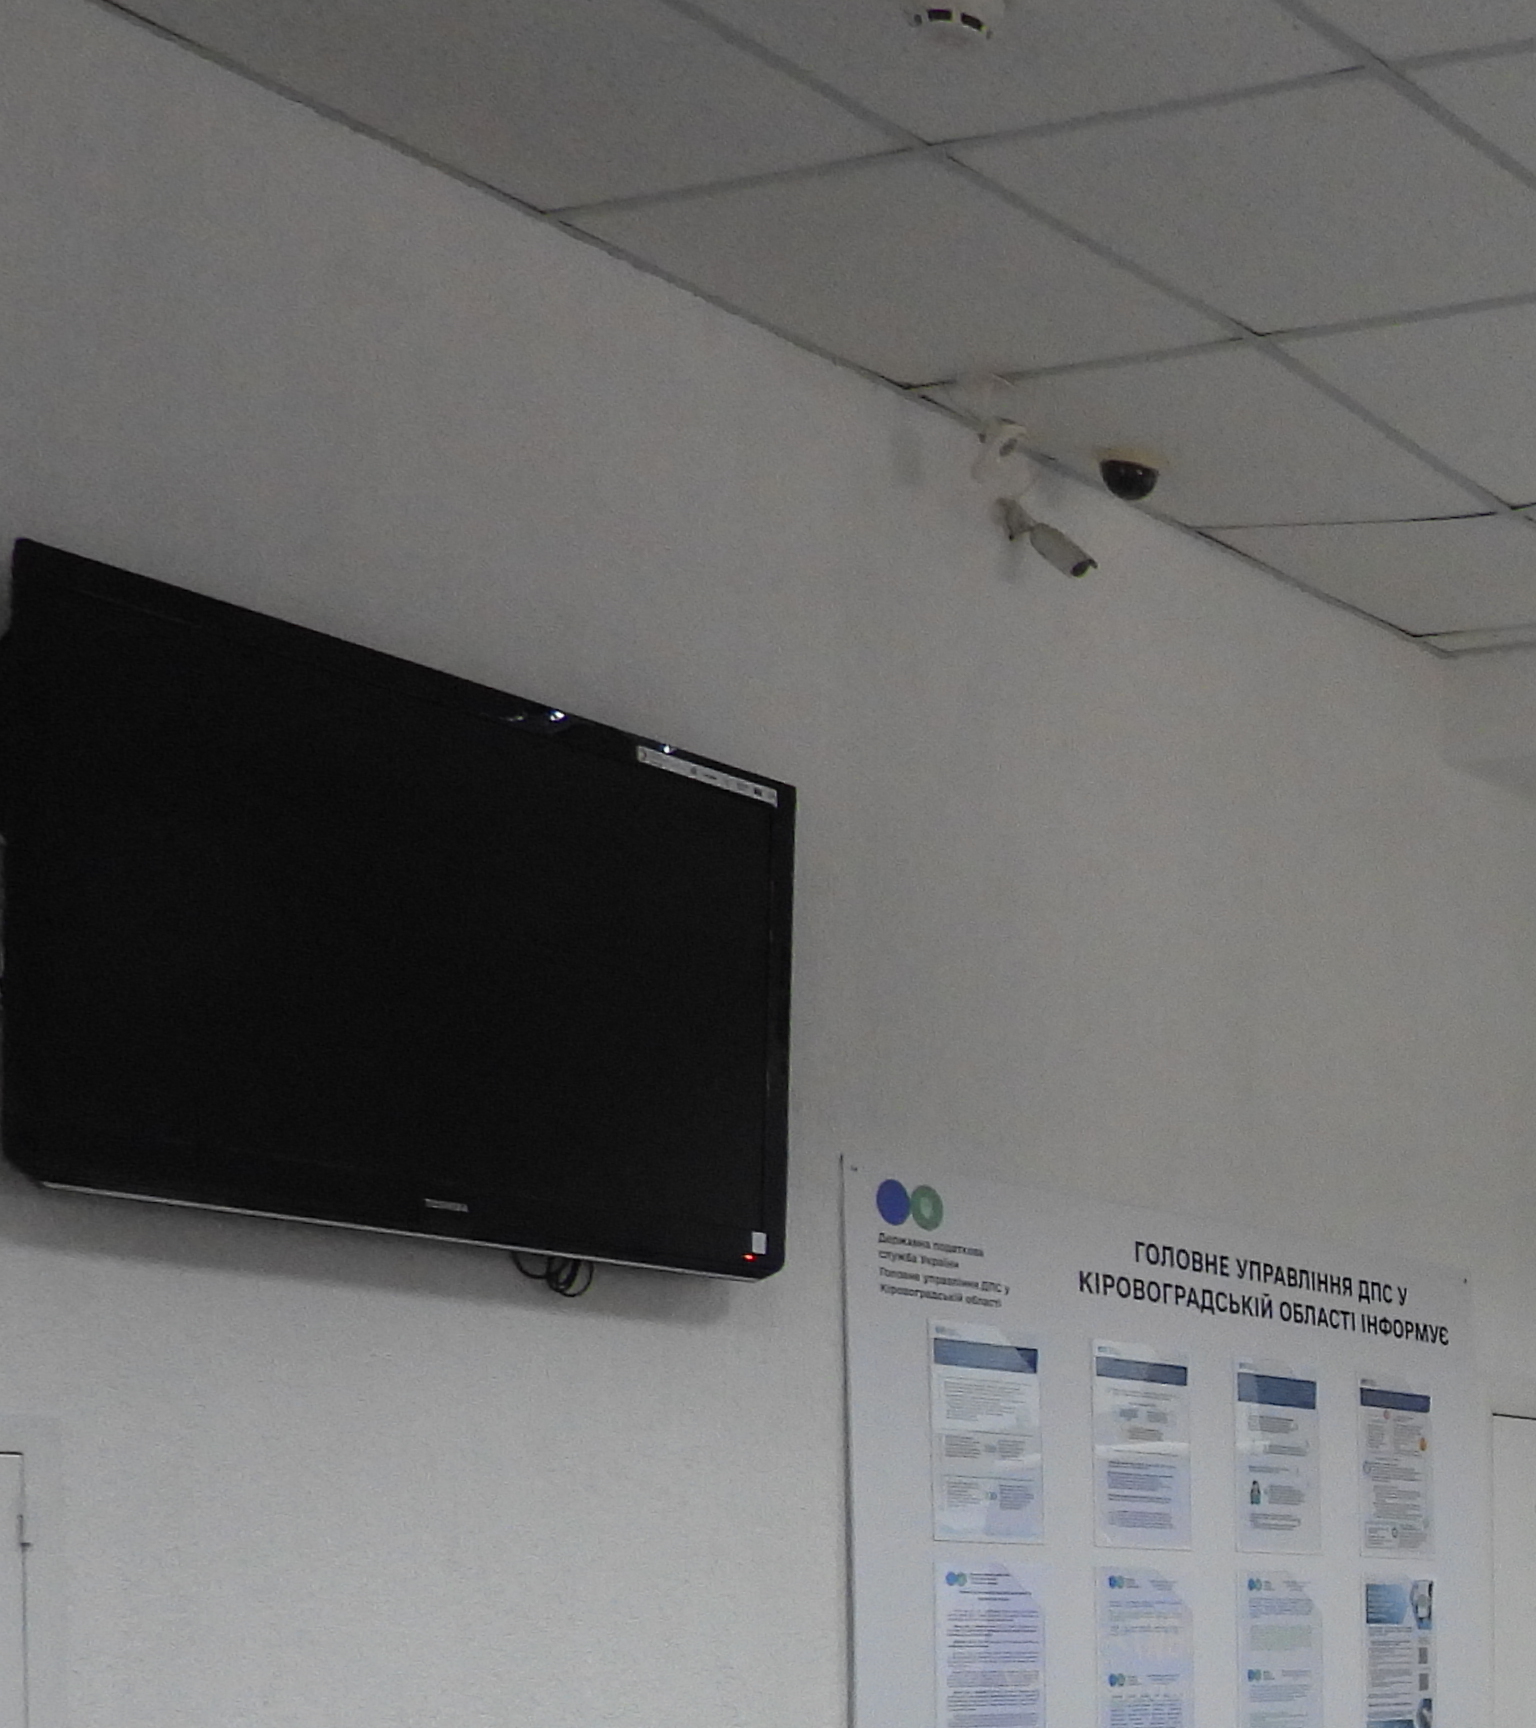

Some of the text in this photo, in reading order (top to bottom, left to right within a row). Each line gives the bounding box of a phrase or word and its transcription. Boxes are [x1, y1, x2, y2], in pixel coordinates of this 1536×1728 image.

[1079, 1270, 1449, 1346] КІРОВОГРАДСЬКІЙ ОБЛАСТІ ІНФОРМУЄ
[1135, 1241, 1408, 1306] ГОЛОВНЕ УПРАВЛІННЯ ДПС У
